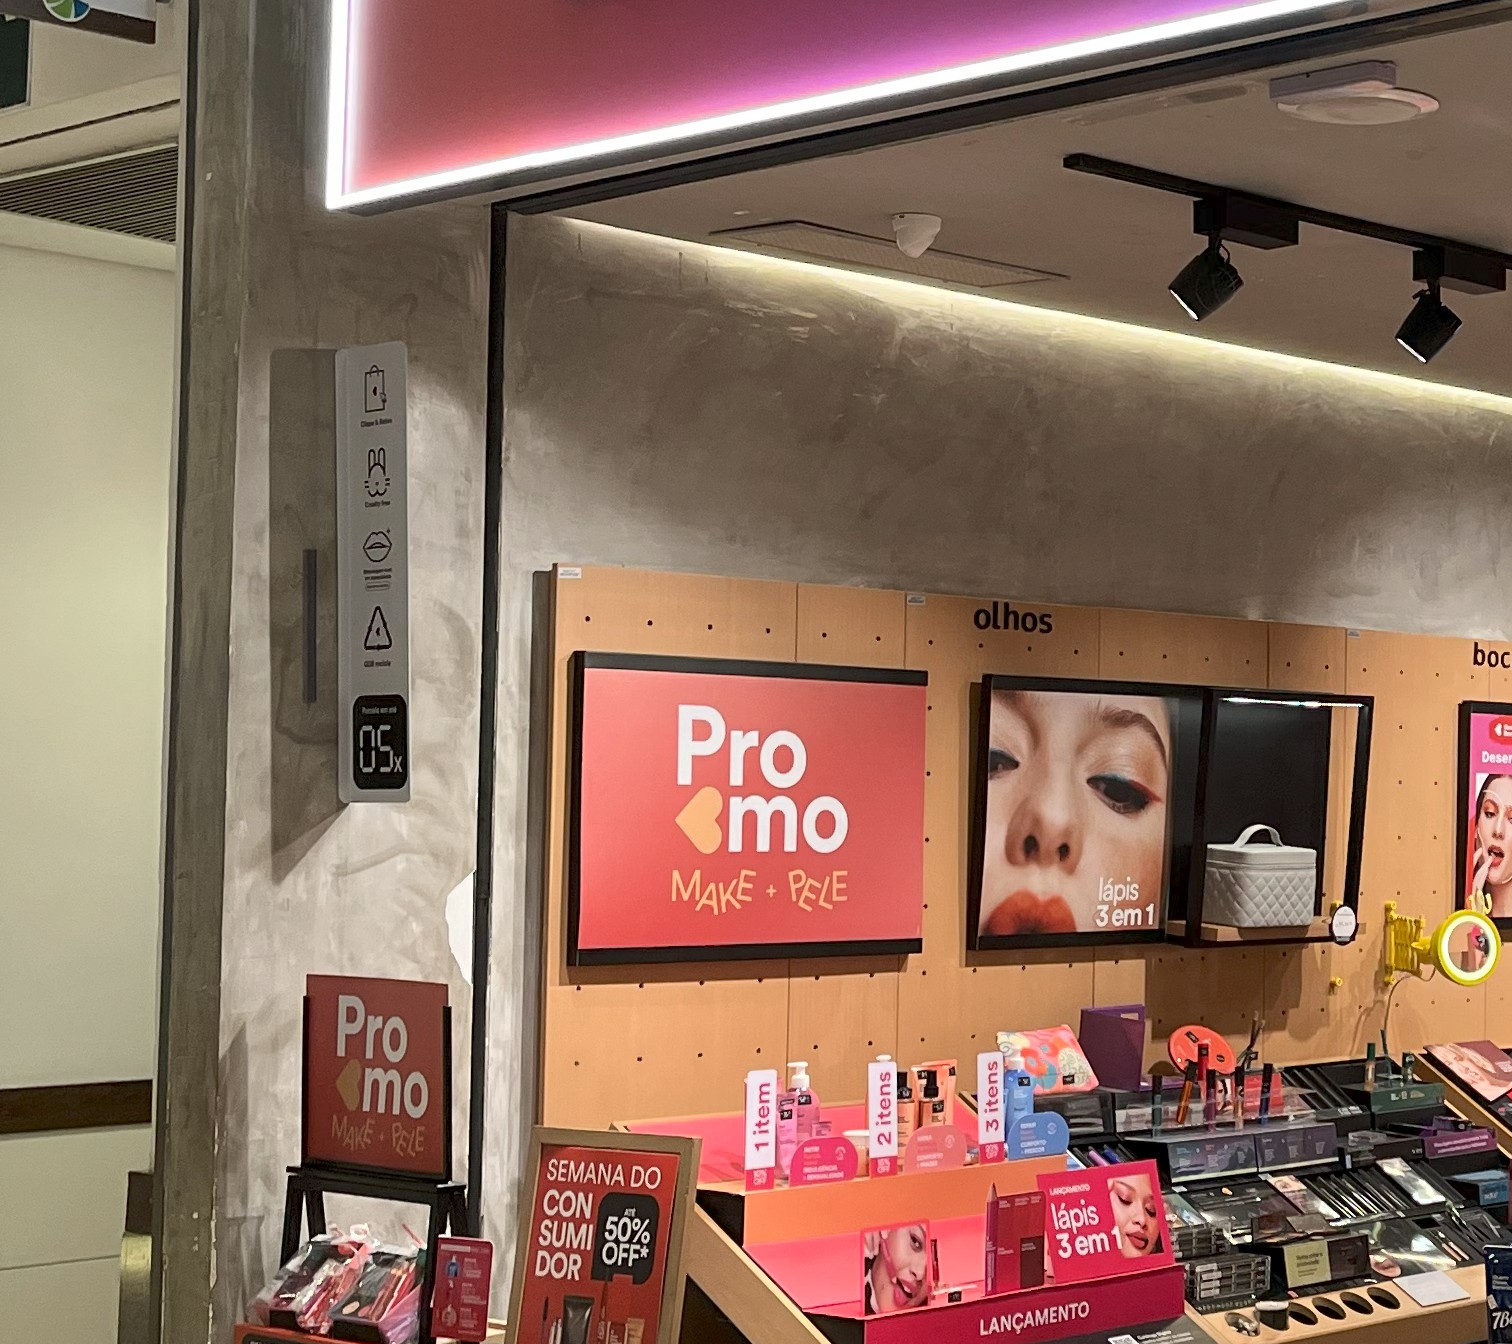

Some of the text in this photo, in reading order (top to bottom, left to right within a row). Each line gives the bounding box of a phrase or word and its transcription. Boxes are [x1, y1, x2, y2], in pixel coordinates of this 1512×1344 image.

[973, 601, 1053, 634] olhos
[677, 704, 807, 789] Pro
[728, 794, 849, 854] mo
[671, 869, 848, 916] MAKE + PELE
[1098, 876, 1140, 907] lápis
[1095, 903, 1155, 928] 3 em 1
[336, 994, 408, 1064] Pro
[362, 1065, 429, 1119] mo
[875, 1071, 892, 1146] 2 itens
[984, 1060, 999, 1133] 3 itens
[753, 1082, 771, 1152] 1 item
[331, 1114, 376, 1152] MAKE
[392, 1121, 426, 1157] PELE
[546, 1158, 661, 1190] SEMANA DO
[1050, 1183, 1091, 1196] LANÇAMENTO
[543, 1189, 593, 1219] CON
[1051, 1199, 1100, 1235] lápis
[538, 1219, 594, 1251] SUMI
[604, 1215, 651, 1245] 50%
[1056, 1225, 1123, 1259] 3 em 1
[535, 1250, 582, 1281] DOR
[980, 1301, 1090, 1336] LANÇAMENTO
